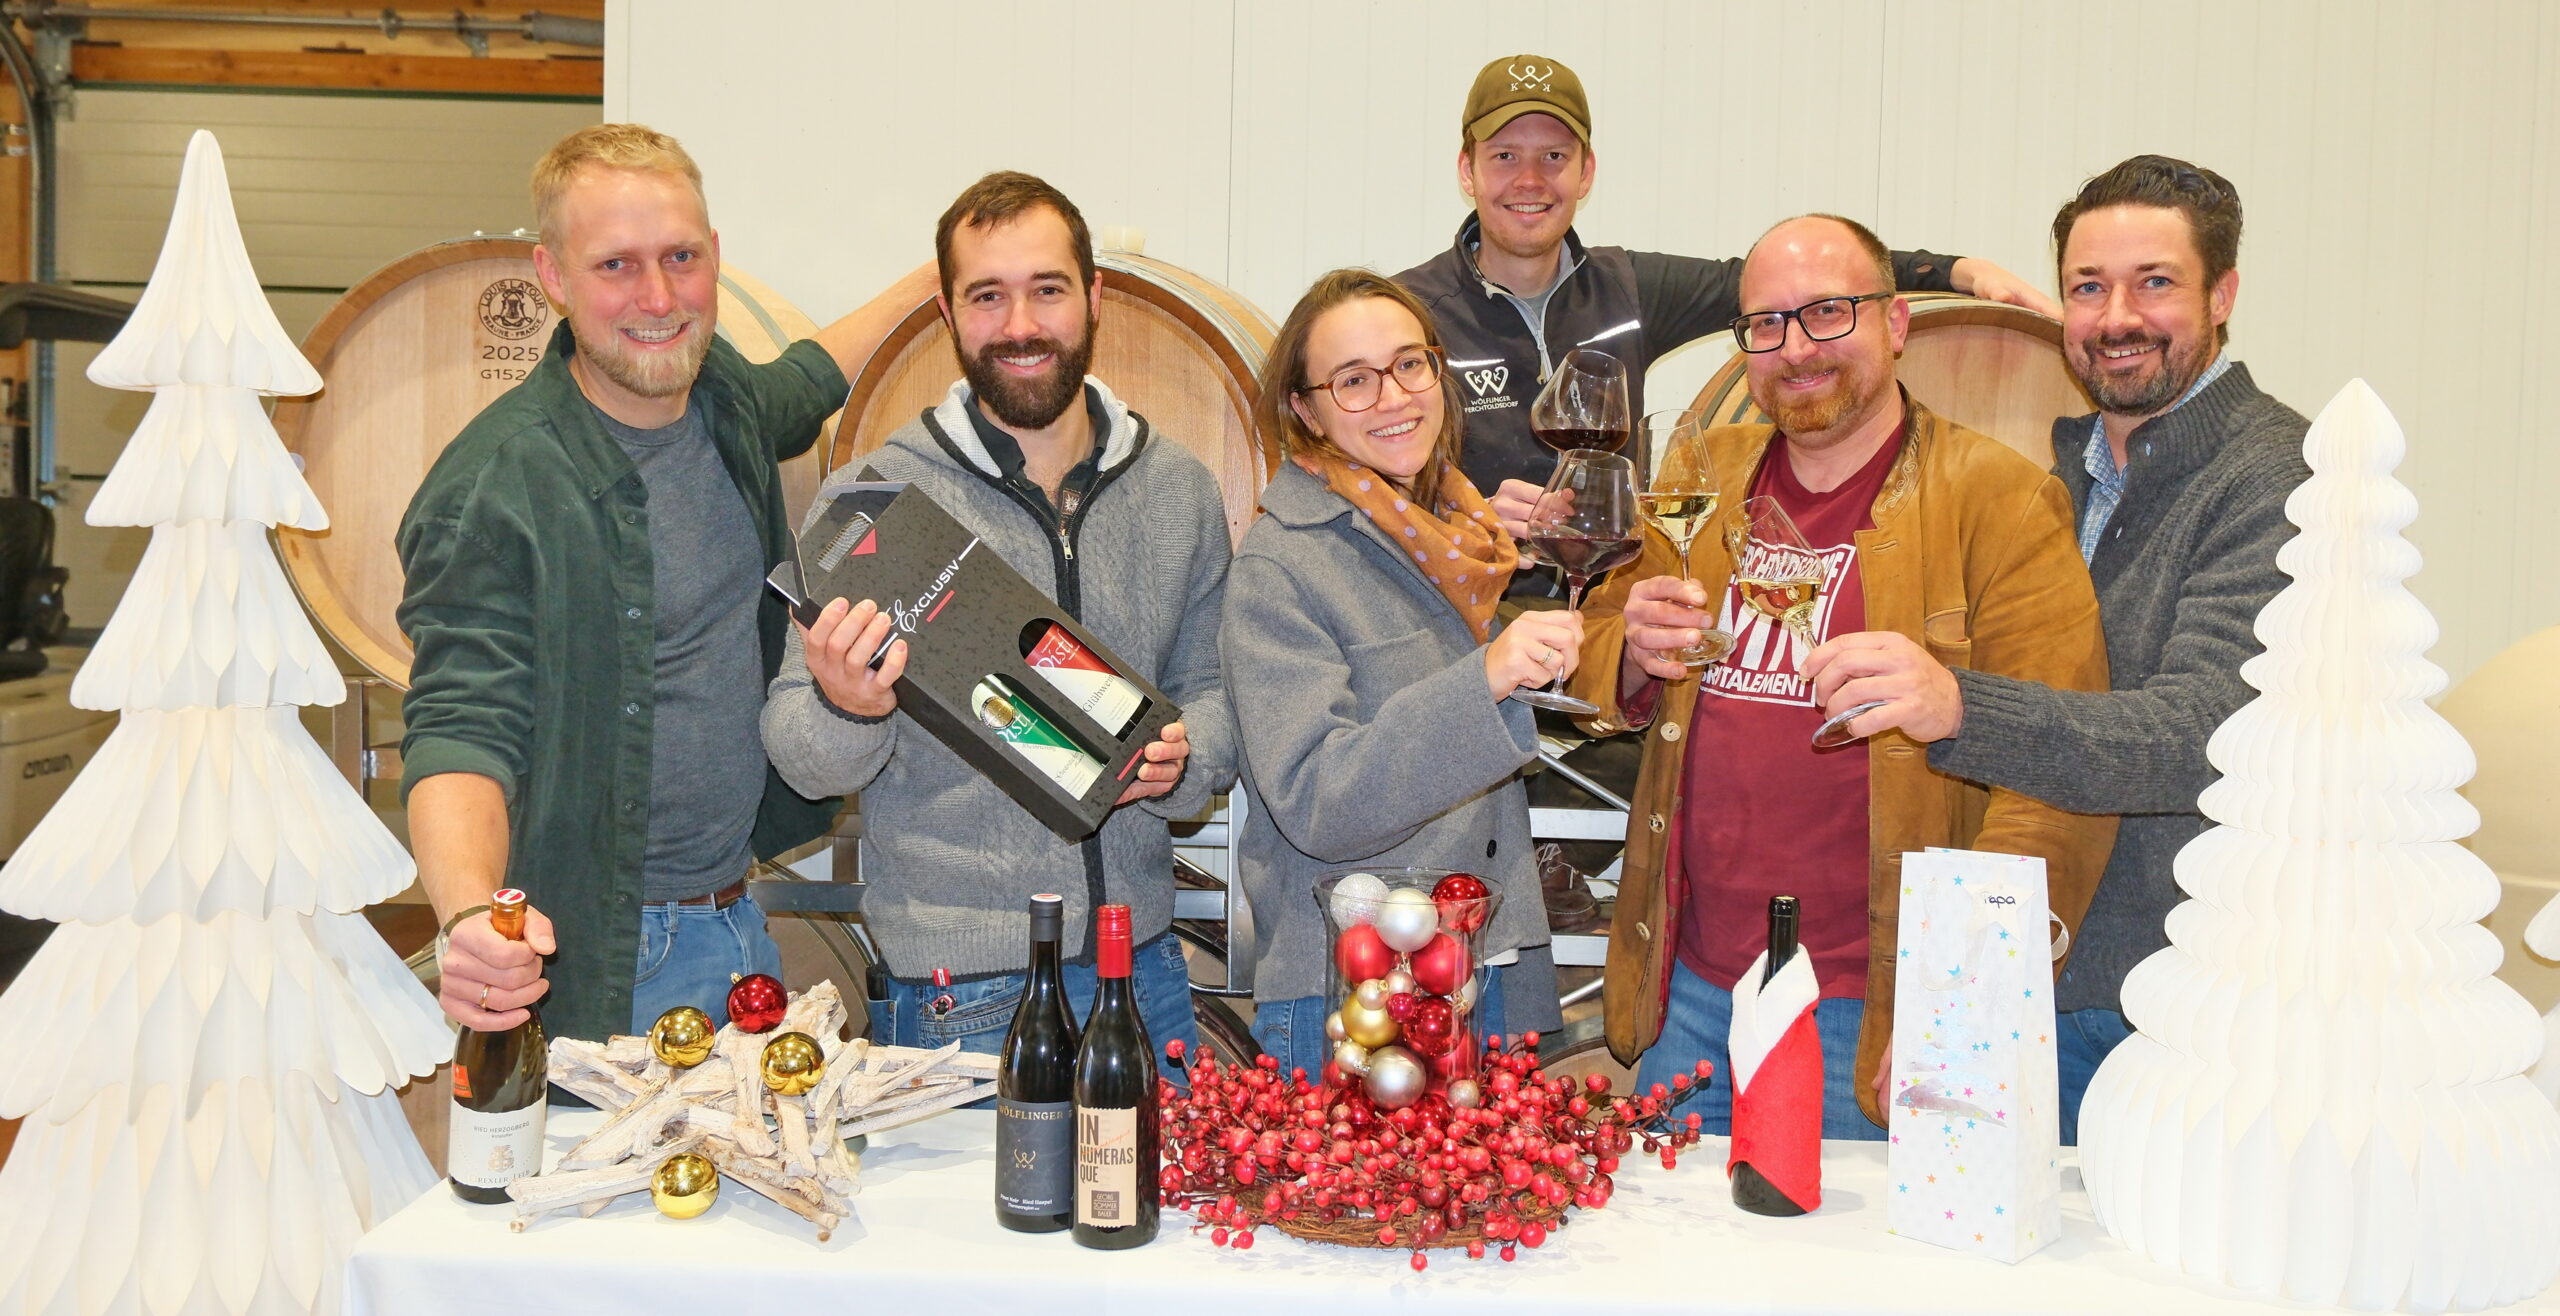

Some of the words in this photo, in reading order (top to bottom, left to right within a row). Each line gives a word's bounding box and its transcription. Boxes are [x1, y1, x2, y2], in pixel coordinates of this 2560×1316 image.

[481, 281, 507, 307] LOUIS
[510, 280, 545, 309] LATOUR
[483, 315, 509, 337] BEAUNE
[516, 318, 543, 337] FRANCE
[483, 345, 539, 361] 2025
[481, 369, 527, 380] G152
[1082, 674, 1116, 713] Glühwein
[999, 1105, 1064, 1120] WÖLFLINGER
[1080, 1113, 1099, 1145] IN
[1080, 1145, 1134, 1165] NUMERAS
[1080, 1164, 1098, 1183] QUE
